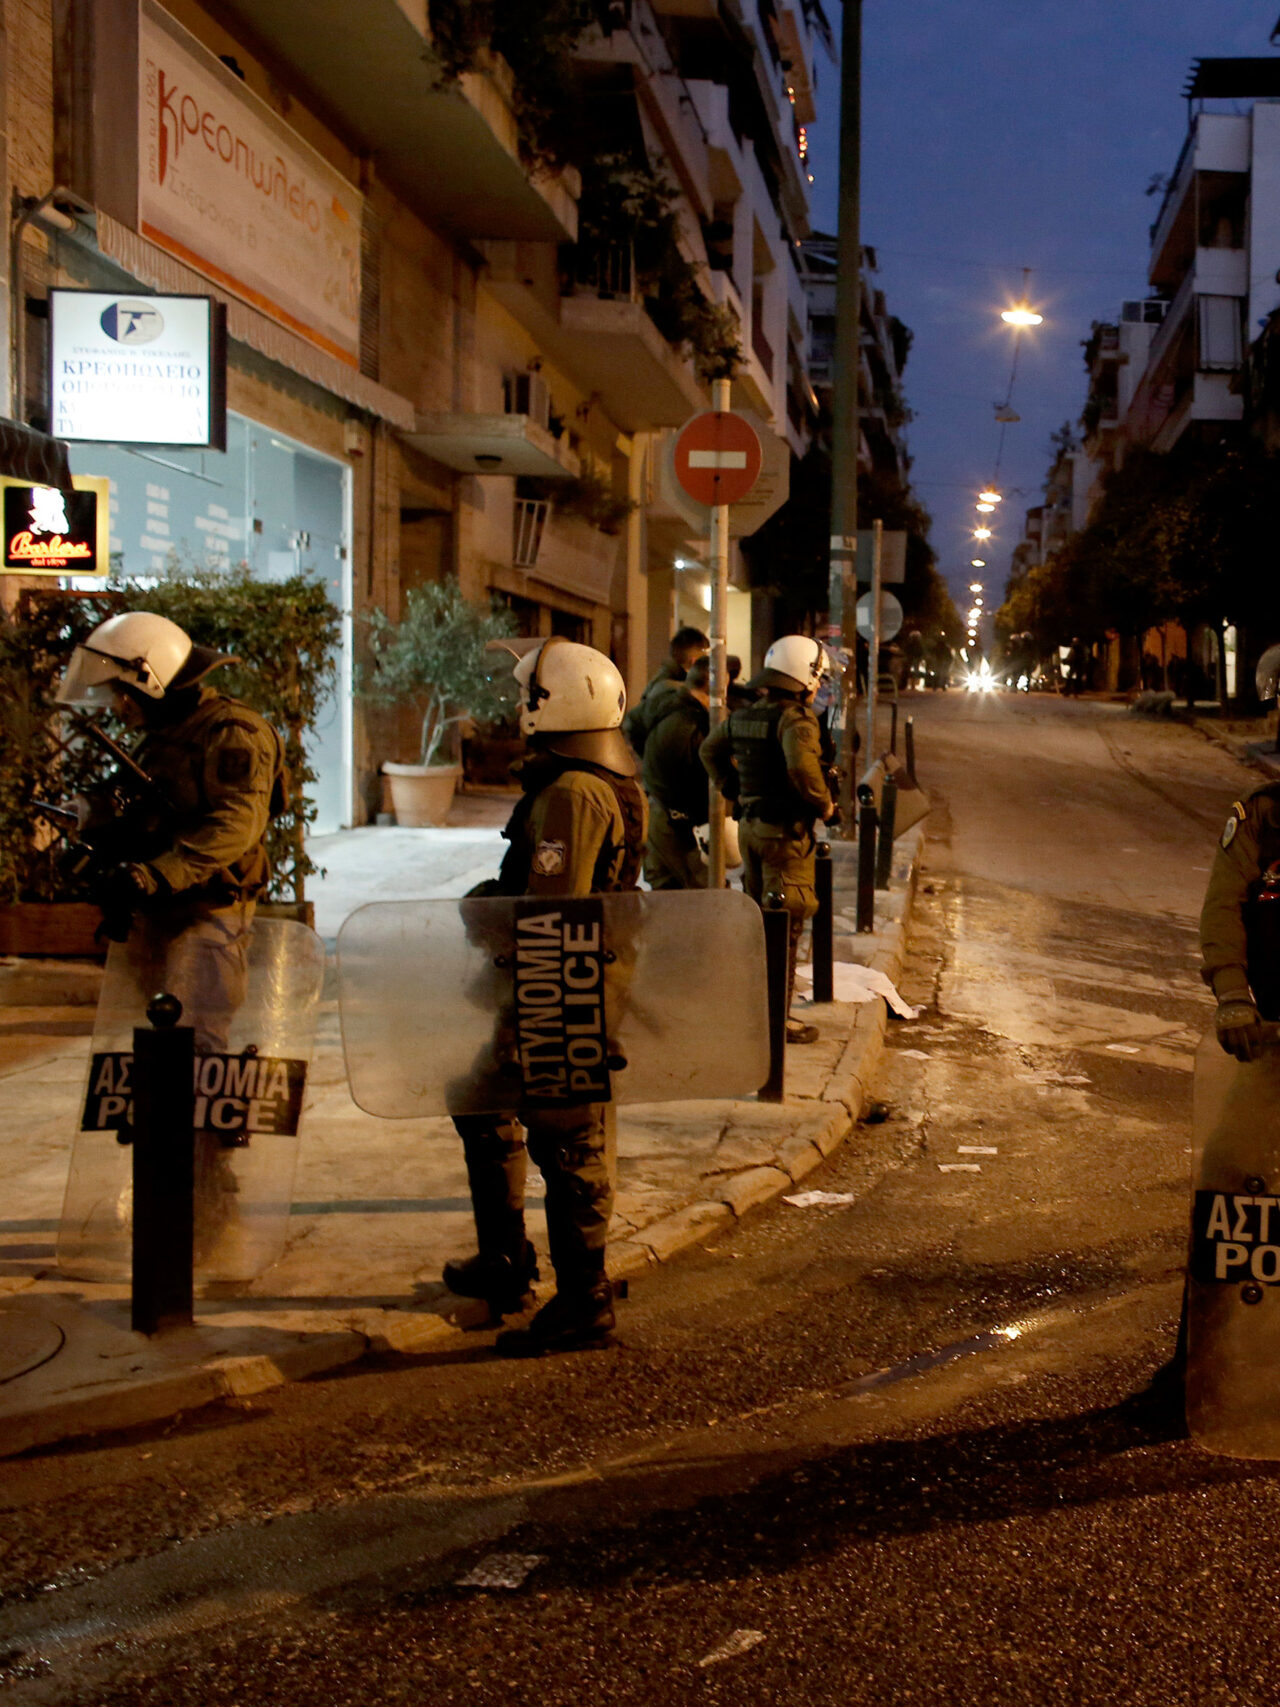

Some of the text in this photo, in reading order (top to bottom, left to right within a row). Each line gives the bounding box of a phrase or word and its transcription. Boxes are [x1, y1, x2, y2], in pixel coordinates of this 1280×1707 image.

[516, 911, 568, 1099] ΑΣΤΥΝΟΜΙΑ
[563, 921, 605, 1091] POLICE
[94, 1056, 290, 1101] ΑΣΟΜΙΑ
[97, 1096, 278, 1132] PICE
